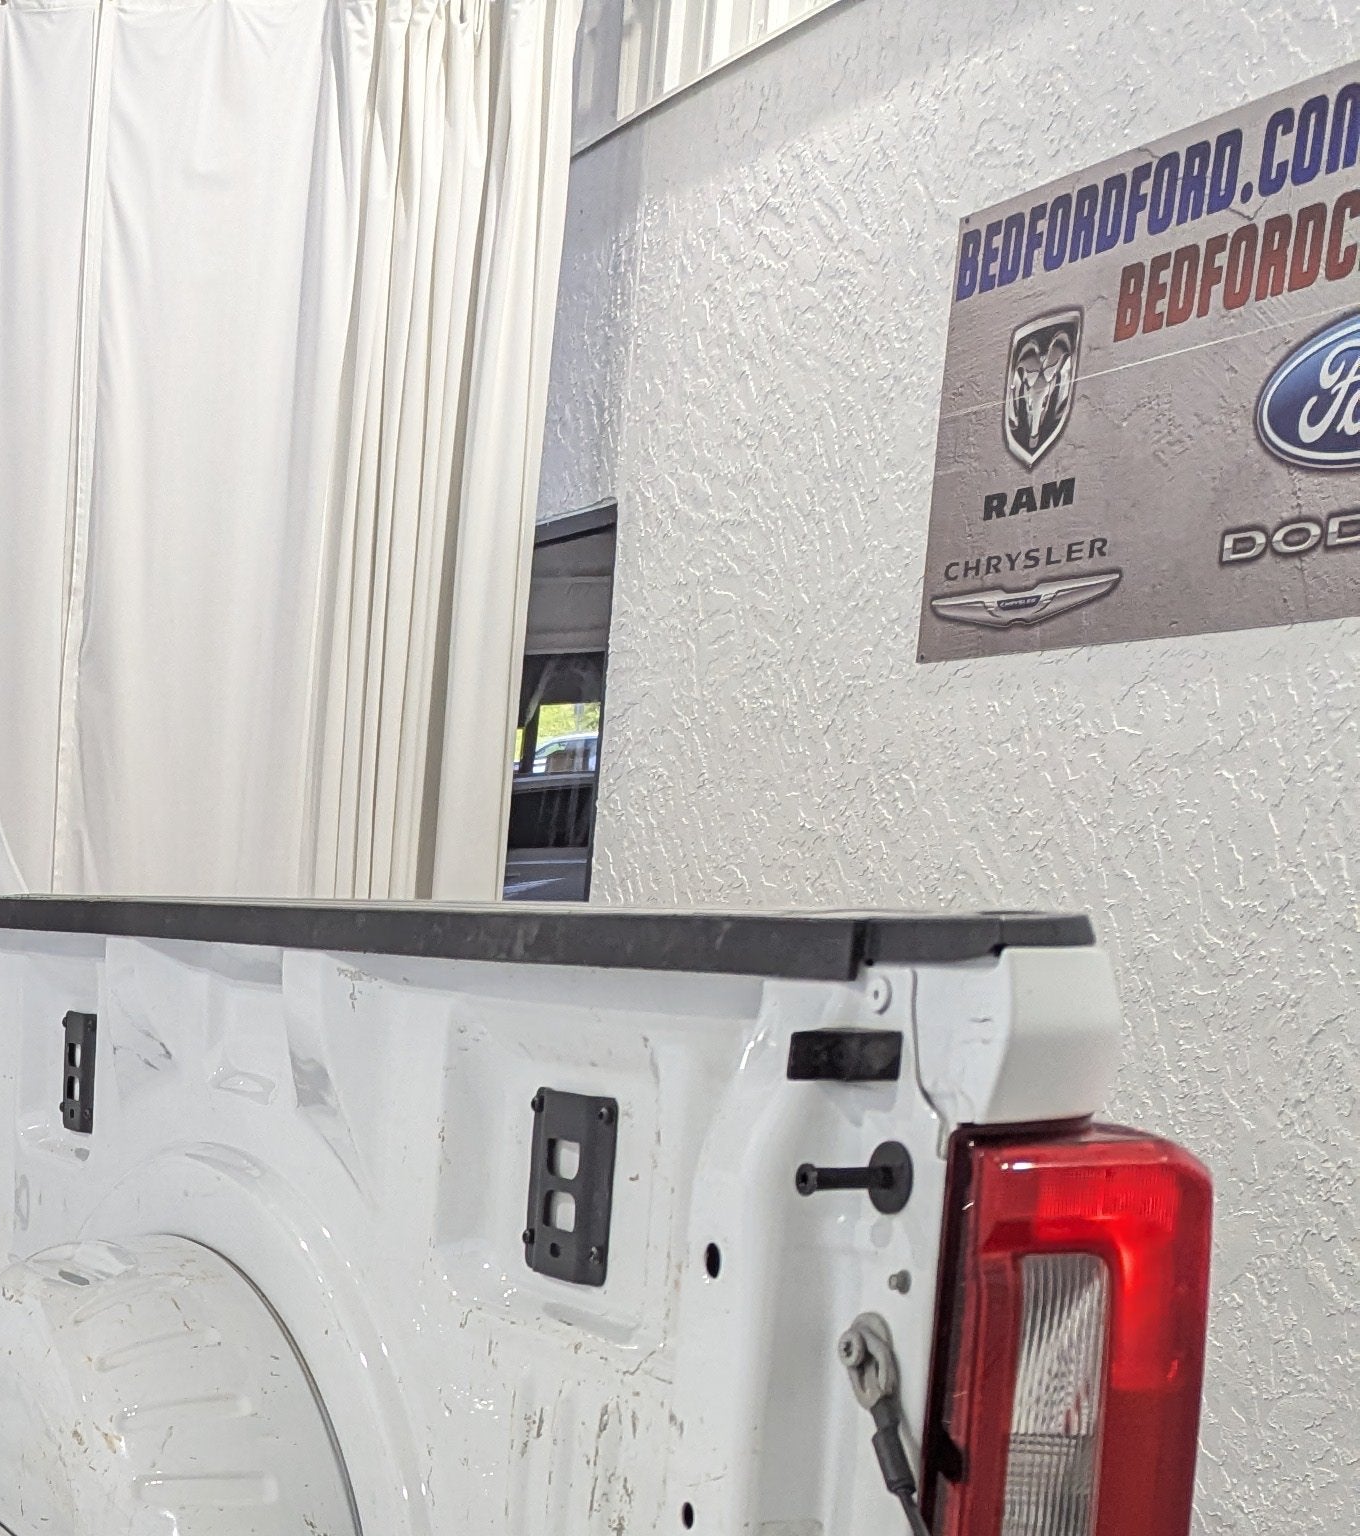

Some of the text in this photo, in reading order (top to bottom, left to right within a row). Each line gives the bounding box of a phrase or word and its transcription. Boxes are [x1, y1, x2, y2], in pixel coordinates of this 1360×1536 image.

[1114, 188, 1360, 342] BEDFORDC
[983, 477, 1076, 521] RAM
[944, 537, 1108, 581] CHRYSLER
